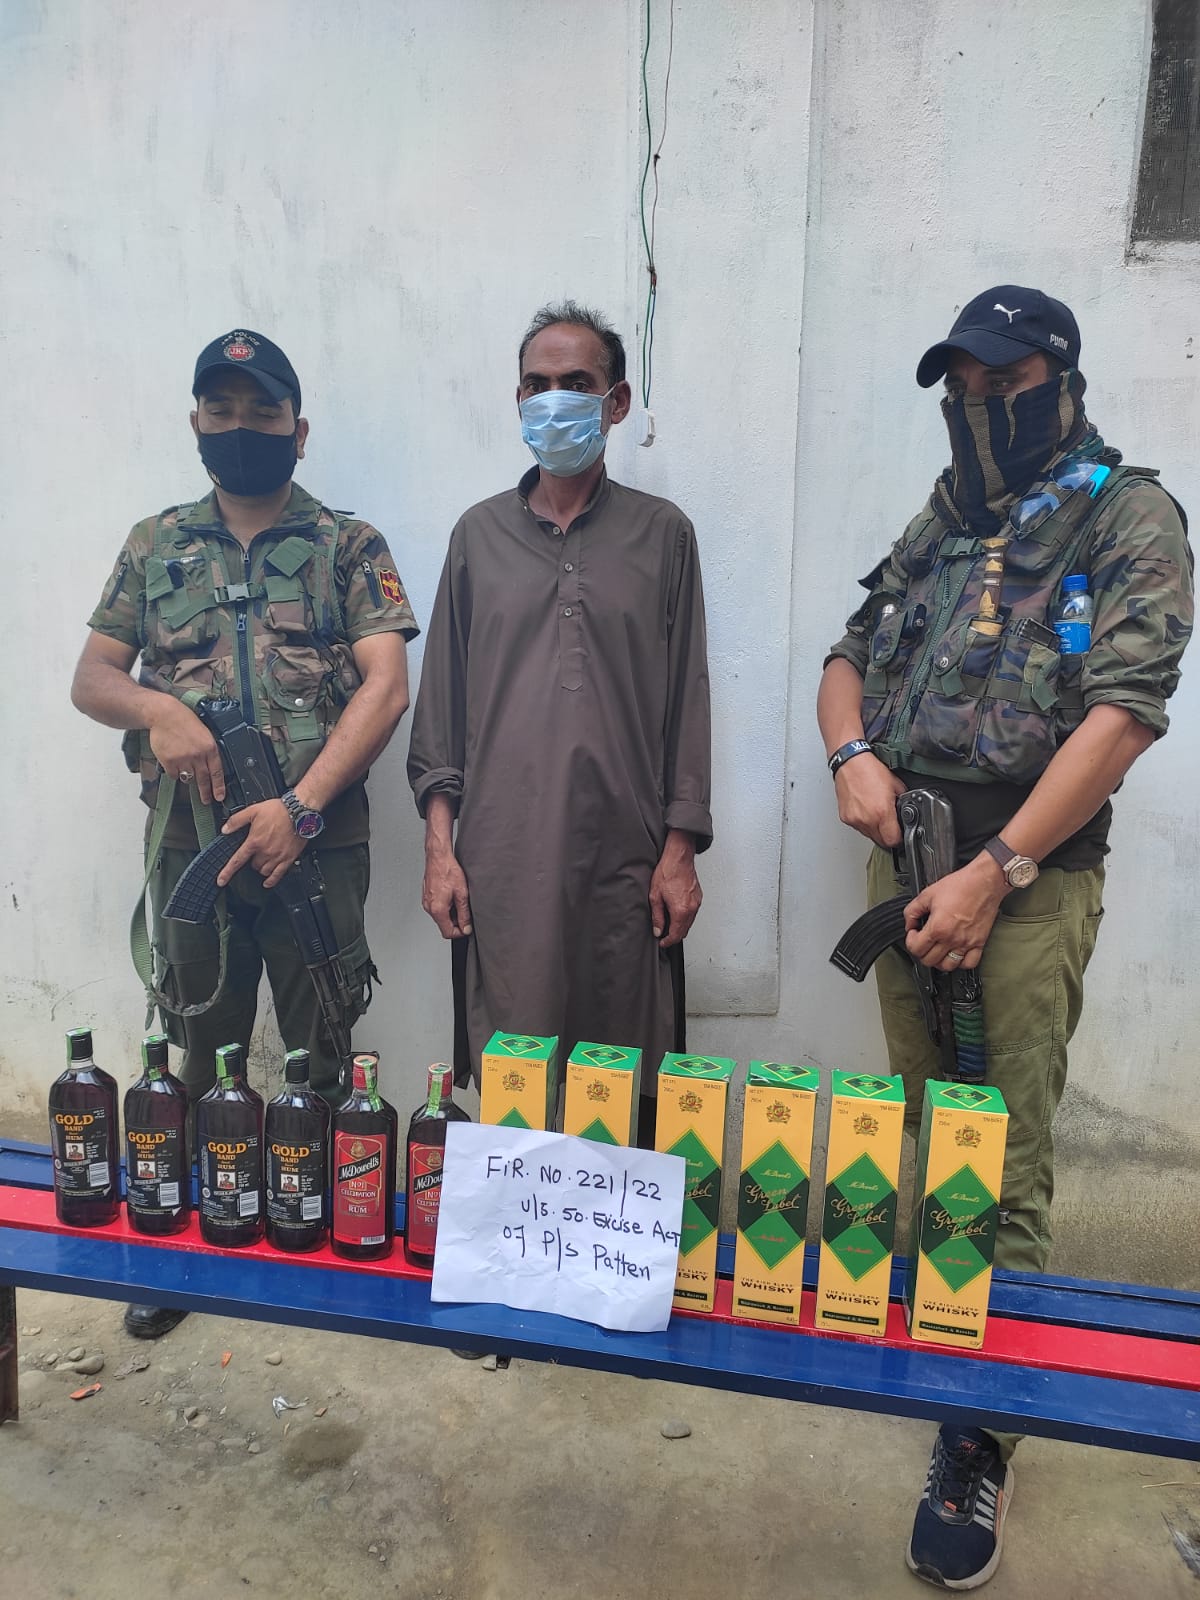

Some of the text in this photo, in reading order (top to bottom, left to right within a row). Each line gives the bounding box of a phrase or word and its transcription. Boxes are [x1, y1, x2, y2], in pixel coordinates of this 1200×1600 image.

[1050, 333, 1069, 351] PUMA
[55, 1113, 94, 1125] GOLD
[128, 1131, 166, 1144] GOLD
[207, 1141, 247, 1154] GOLD
[271, 1143, 310, 1157] GOLD
[339, 1155, 379, 1180] McDowell's
[340, 1189, 376, 1198] CELEBRATION
[685, 1182, 713, 1199] abel
[744, 1184, 787, 1204] Green
[348, 1204, 367, 1213] RUM
[761, 1193, 801, 1214] Label
[830, 1197, 874, 1218] Green
[424, 1215, 438, 1223] RU
[847, 1208, 889, 1229] Label
[929, 1209, 976, 1230] Green
[946, 1220, 991, 1240] Label
[593, 1244, 650, 1281] Patten
[678, 1271, 708, 1281] ISKY
[741, 1281, 794, 1294] WHISKY
[825, 1293, 880, 1306] WHISKY
[923, 1303, 979, 1318] WHISKY
